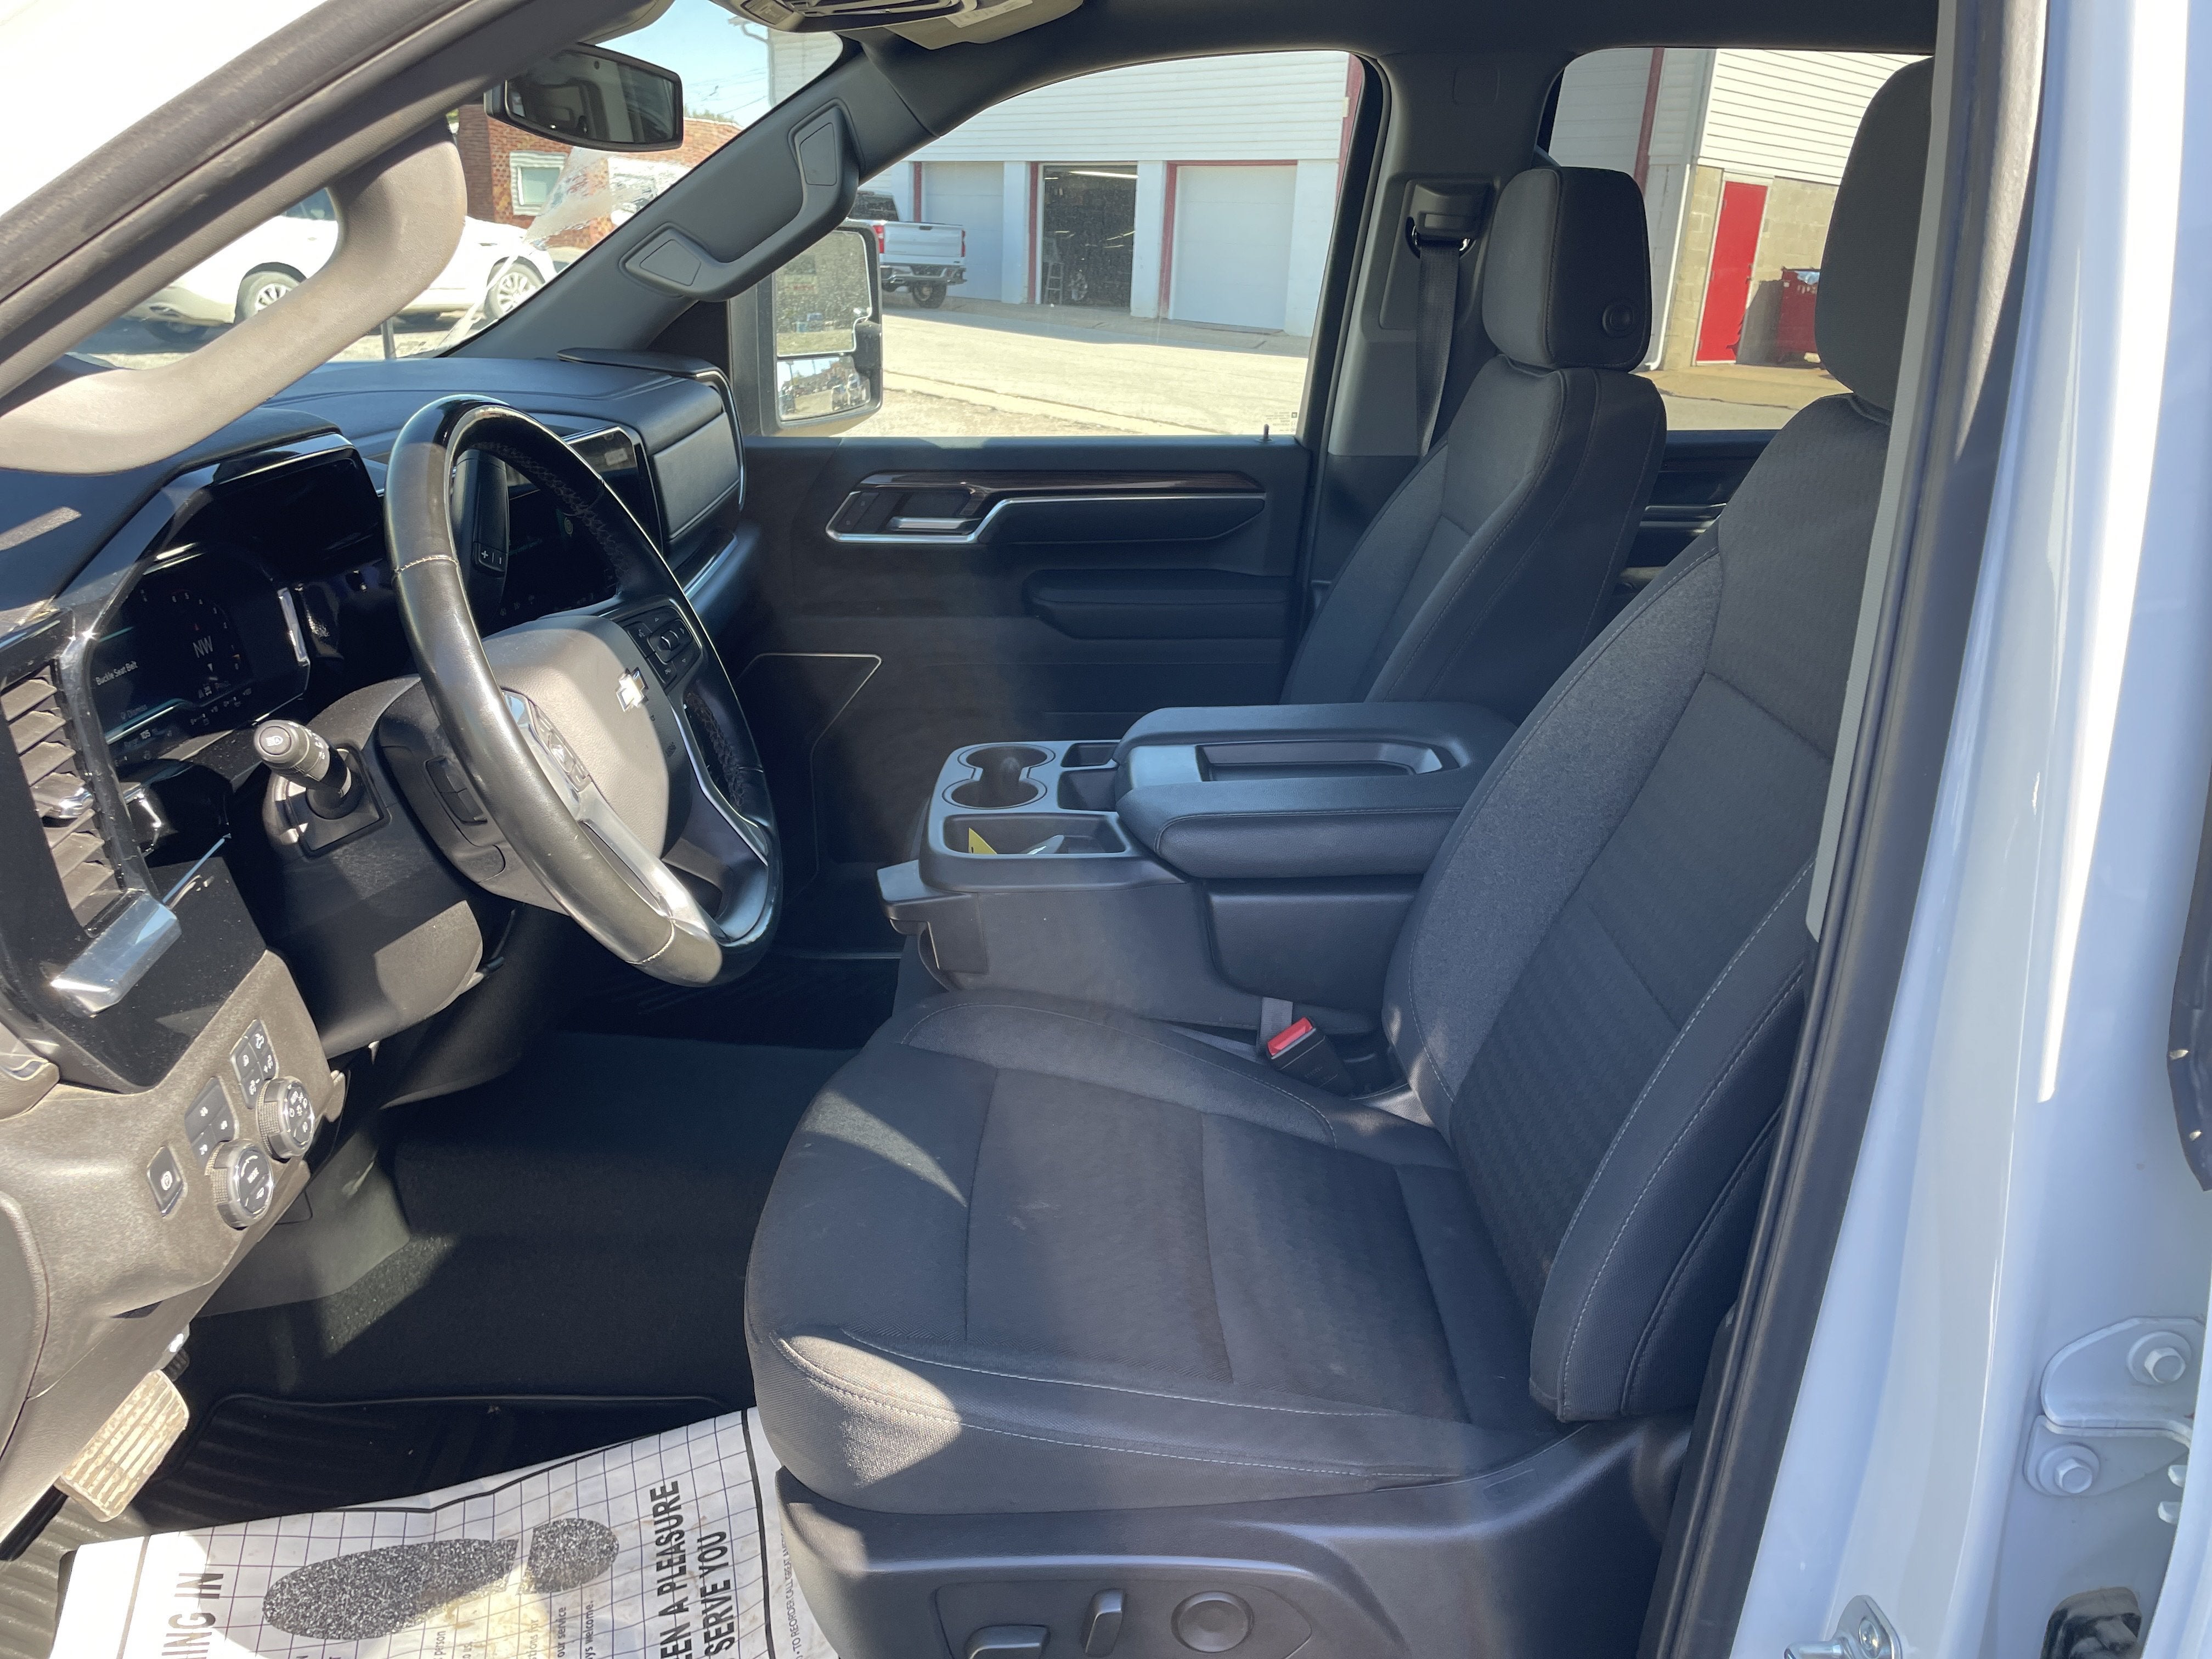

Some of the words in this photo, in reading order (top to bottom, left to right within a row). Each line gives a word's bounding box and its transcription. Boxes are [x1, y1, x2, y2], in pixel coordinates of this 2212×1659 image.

[193, 635, 213, 659] NW
[95, 672, 115, 686] Buckle
[114, 667, 127, 678] Seat
[125, 661, 138, 672] Belt
[650, 1480, 687, 1598] PLEASURE
[696, 1531, 730, 1579] YOU
[783, 1559, 792, 1580] GREAT
[173, 1573, 224, 1599] IN
[785, 1578, 794, 1599] CALL
[658, 1596, 690, 1616] A
[699, 1578, 736, 1657] SERVE
[786, 1597, 800, 1638] REORDER
[161, 1612, 216, 1659] ING
[557, 1606, 567, 1640] service
[583, 1600, 594, 1645] welcome.
[434, 1630, 447, 1656] person
[557, 1642, 566, 1658] our
[584, 1646, 596, 1659] ys
[792, 1637, 802, 1652] TO
